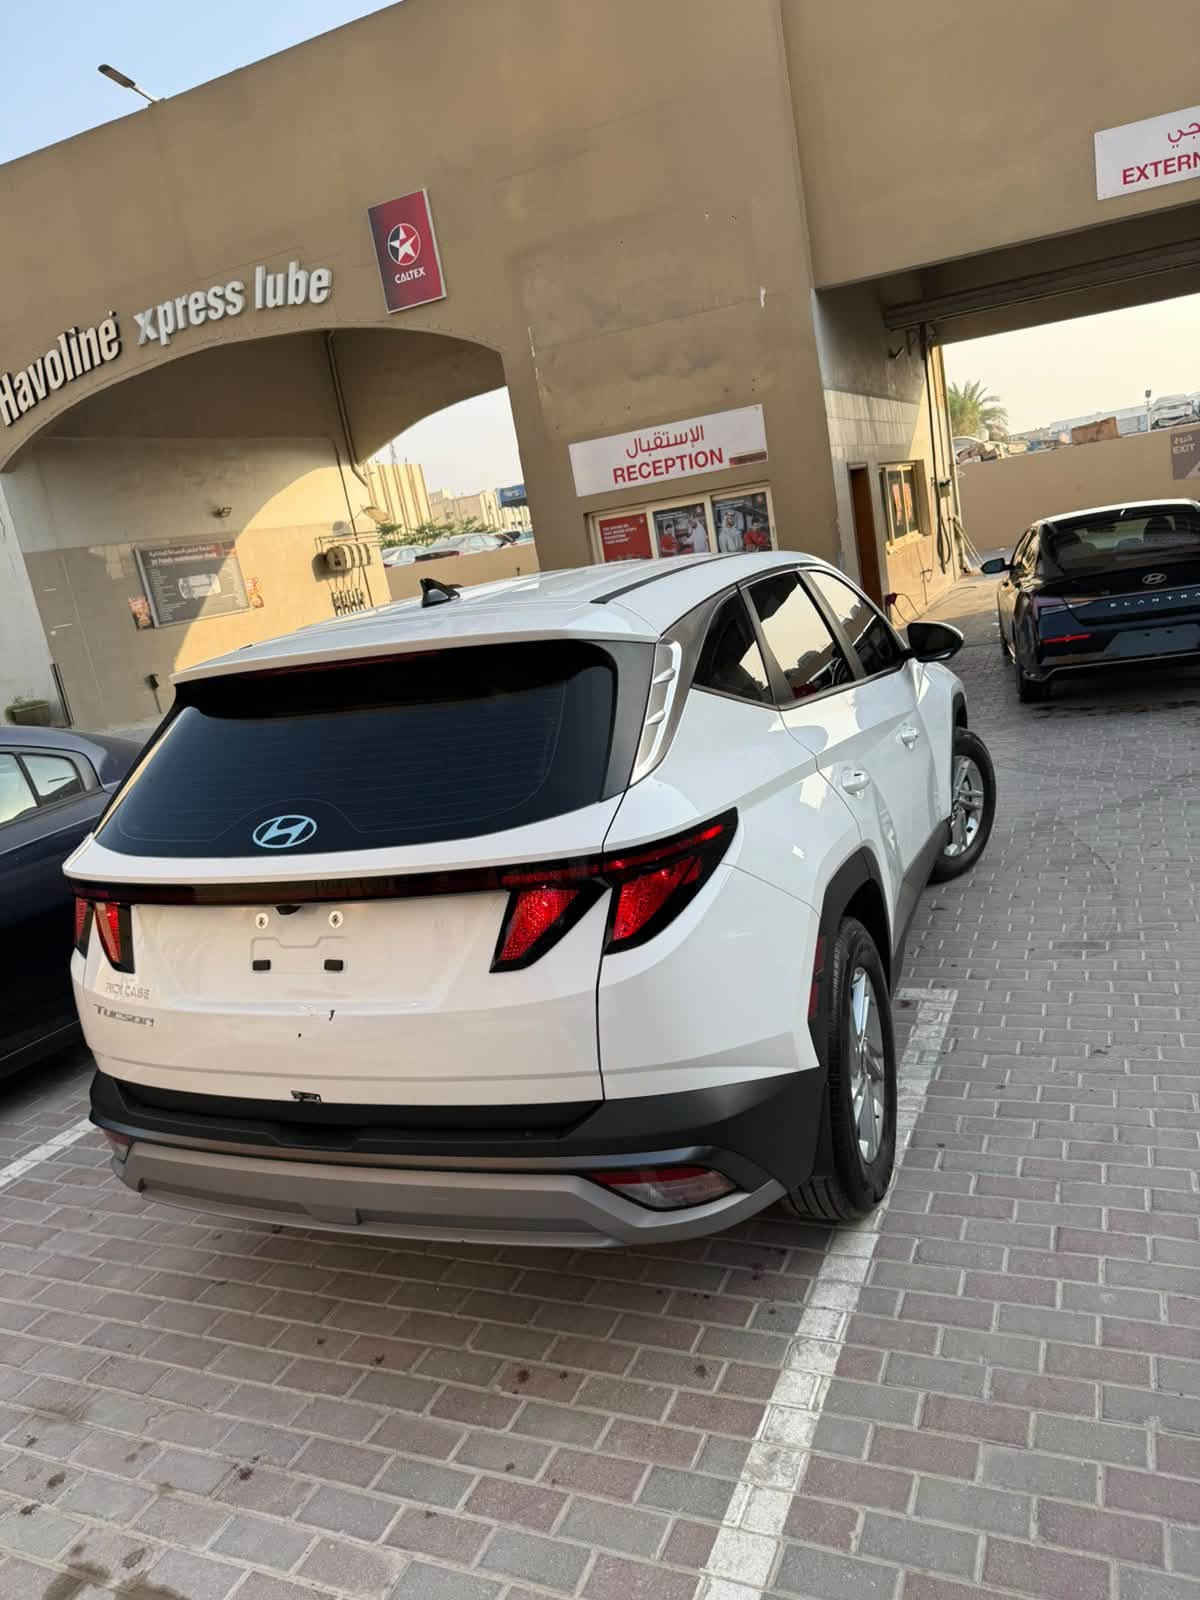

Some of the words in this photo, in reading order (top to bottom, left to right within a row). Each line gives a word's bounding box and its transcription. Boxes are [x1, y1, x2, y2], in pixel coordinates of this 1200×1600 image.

[394, 267, 426, 284] CALTEX
[133, 281, 245, 345] xpress
[255, 262, 332, 309] lube
[1173, 443, 1195, 455] EXIT
[613, 448, 724, 484] RECEPTION
